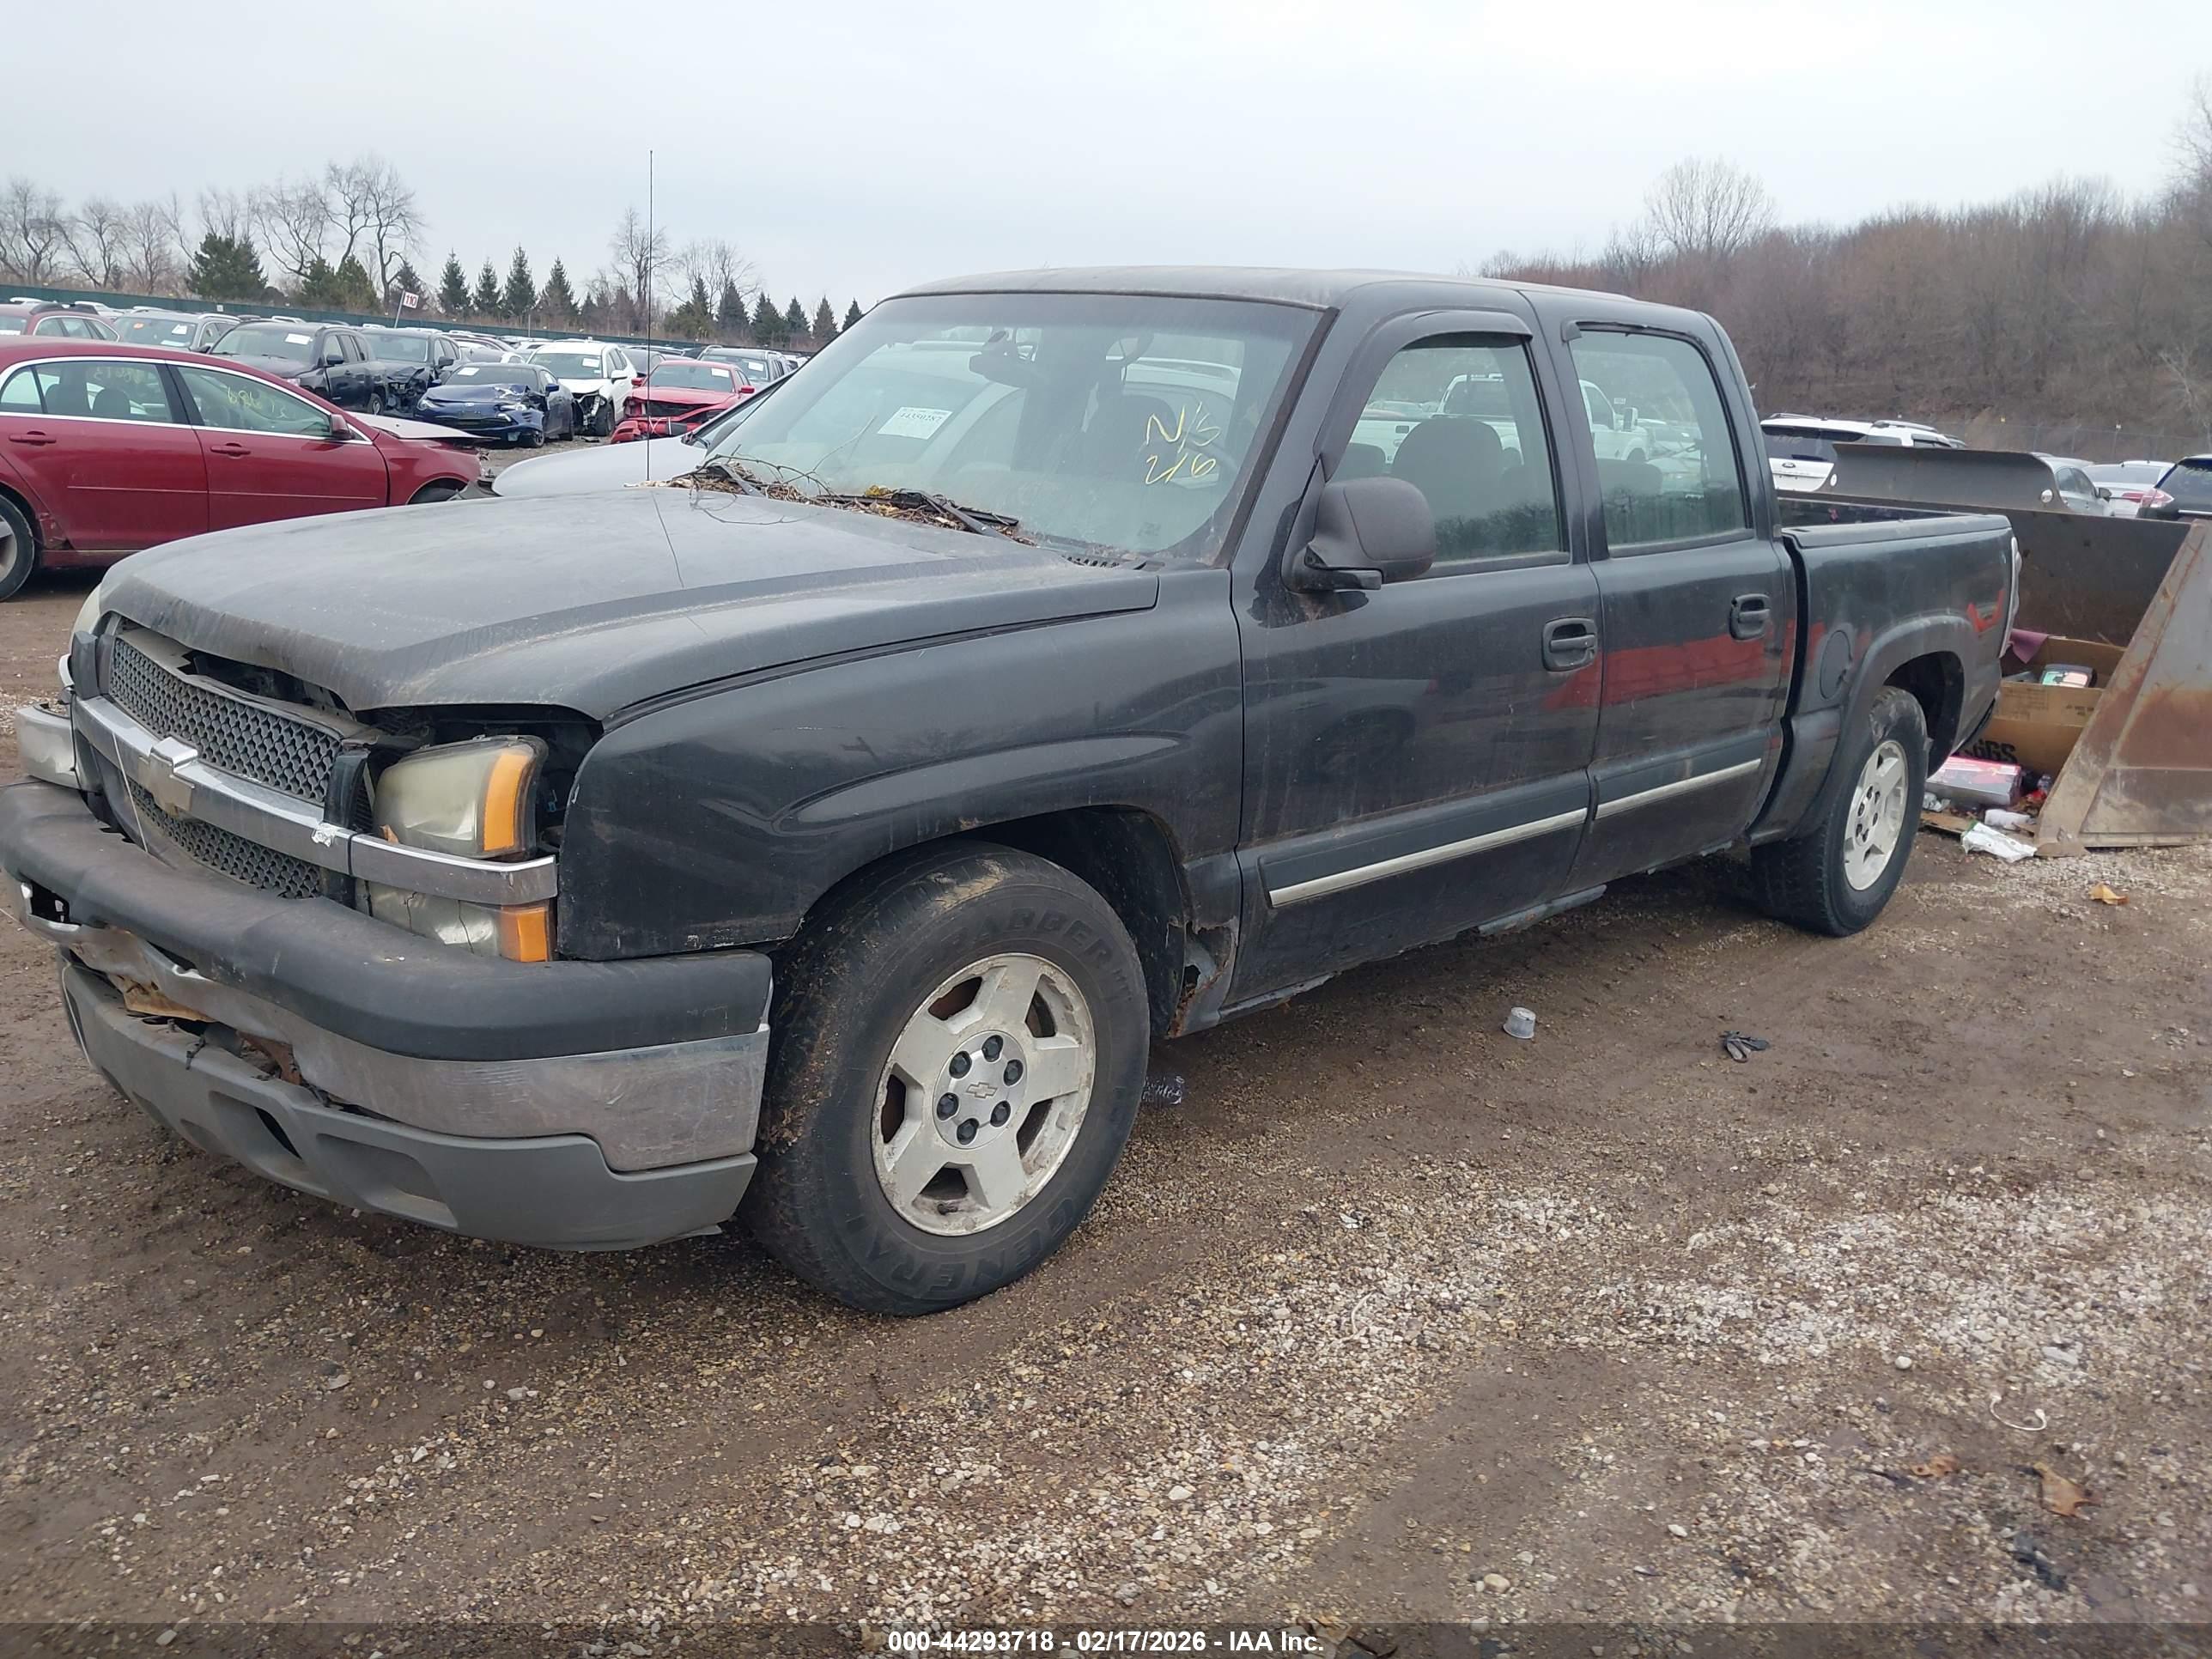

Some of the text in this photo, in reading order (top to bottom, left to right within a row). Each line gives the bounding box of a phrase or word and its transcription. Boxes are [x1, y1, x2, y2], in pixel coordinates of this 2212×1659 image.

[405, 295, 417, 306] 110
[1146, 401, 1221, 453] N/S
[1145, 453, 1216, 485] 2/6
